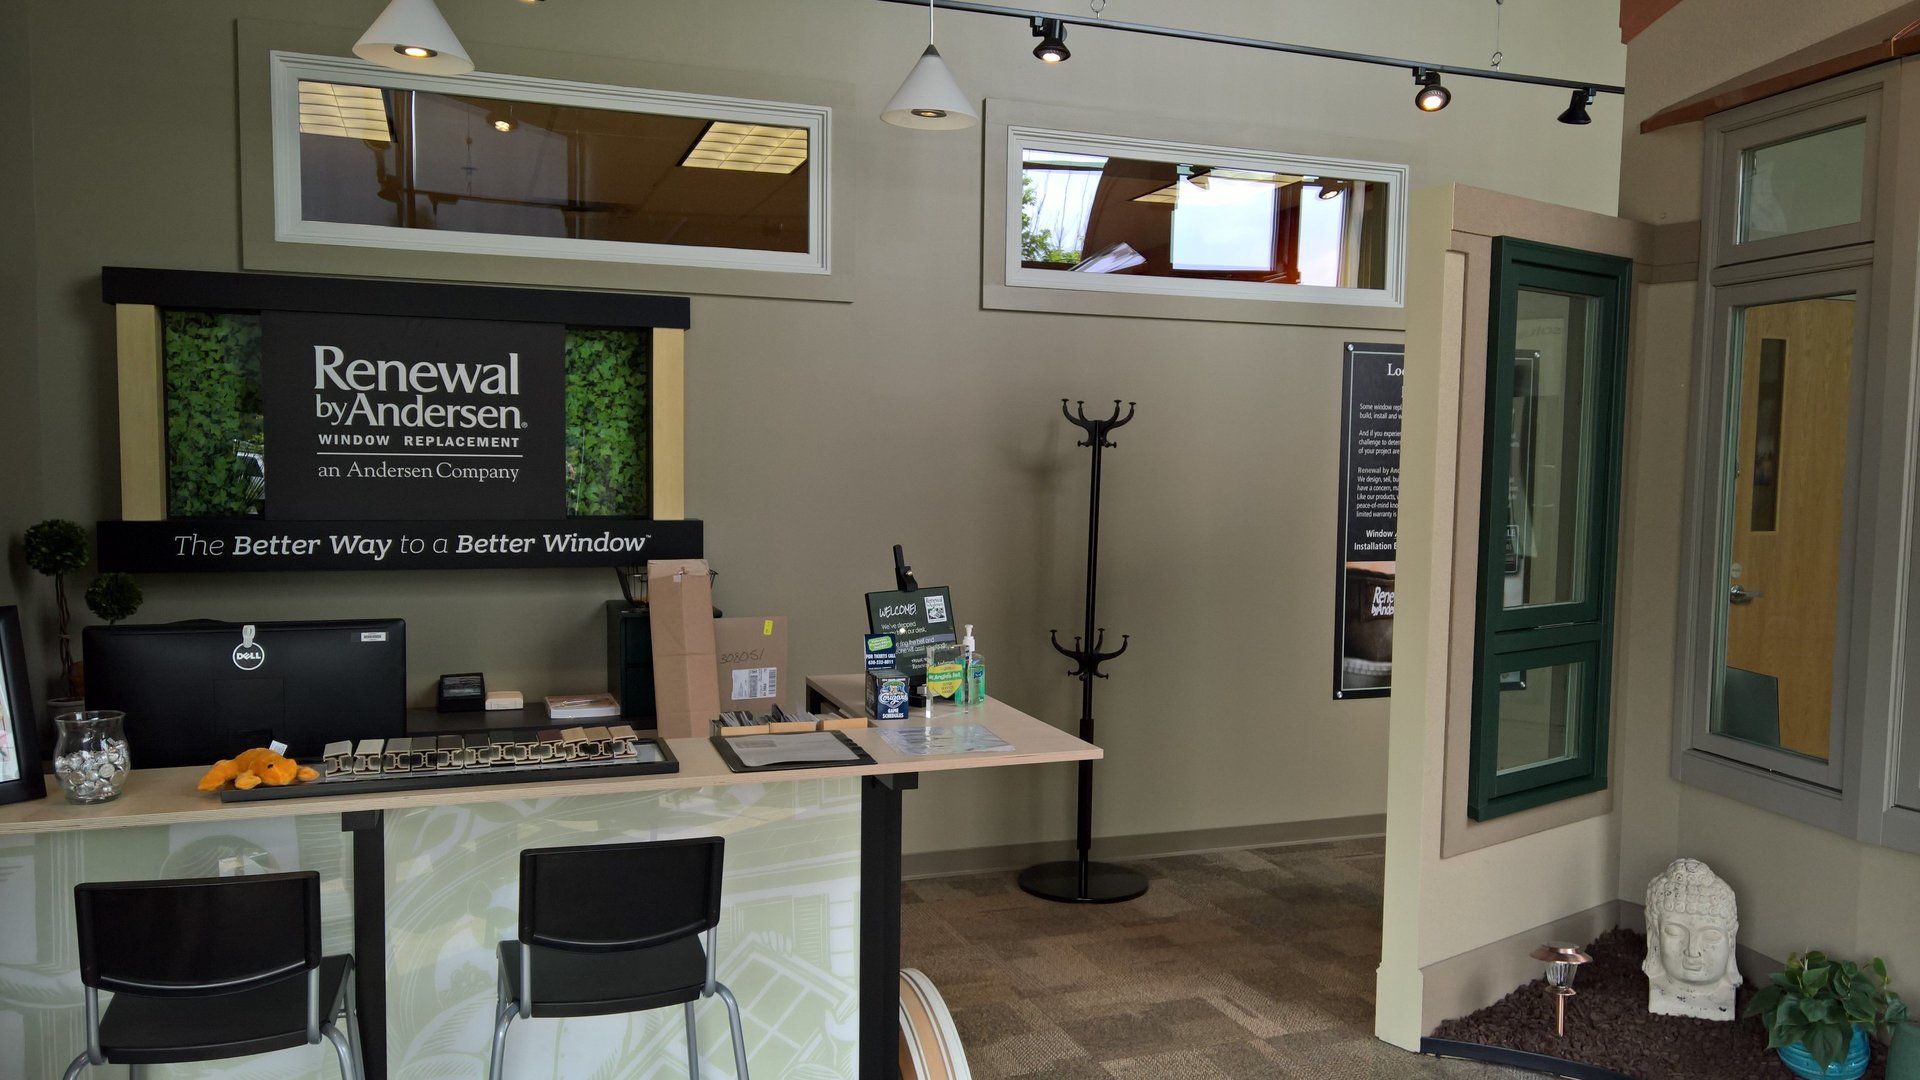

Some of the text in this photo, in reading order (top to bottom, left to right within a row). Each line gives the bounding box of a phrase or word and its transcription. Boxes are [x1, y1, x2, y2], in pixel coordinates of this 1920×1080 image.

[314, 345, 519, 395] Renewal
[1374, 411, 1387, 419] install
[1359, 429, 1369, 437] And
[318, 434, 520, 448] WINDOW REPLACEMENT
[1359, 439, 1381, 447] challenge
[1376, 448, 1391, 456] project
[318, 461, 519, 482] an Andersen Company
[1383, 467, 1389, 475] by
[1367, 476, 1382, 484] design,
[1373, 510, 1392, 518] warranty
[1366, 529, 1393, 538] Window
[174, 533, 225, 556] The
[232, 534, 321, 556] Better
[329, 535, 392, 561] Way
[400, 534, 425, 554] to
[433, 538, 448, 553] a
[456, 533, 535, 554] Better
[1354, 541, 1392, 550] Installation
[879, 602, 917, 618] WELCOME!
[236, 652, 261, 660] DELL
